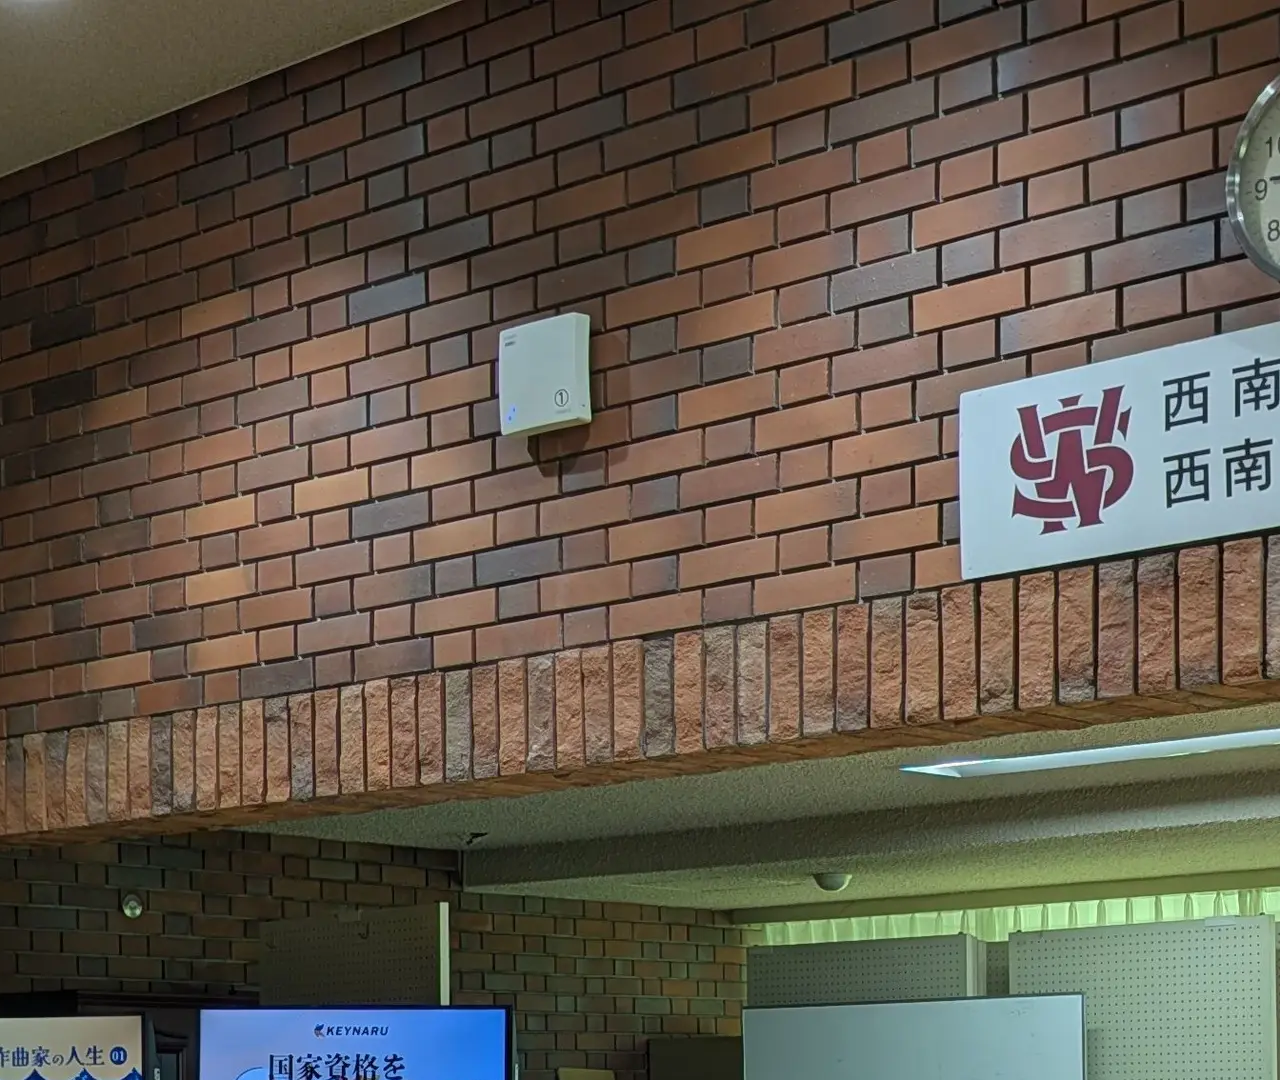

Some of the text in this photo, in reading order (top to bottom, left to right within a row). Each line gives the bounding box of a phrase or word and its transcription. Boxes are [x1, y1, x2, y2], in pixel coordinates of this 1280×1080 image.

[1254, 178, 1268, 201] 9
[1267, 219, 1280, 242] 8
[326, 1025, 389, 1036] KEYNARU
[269, 1054, 406, 1080] 国家資格を
